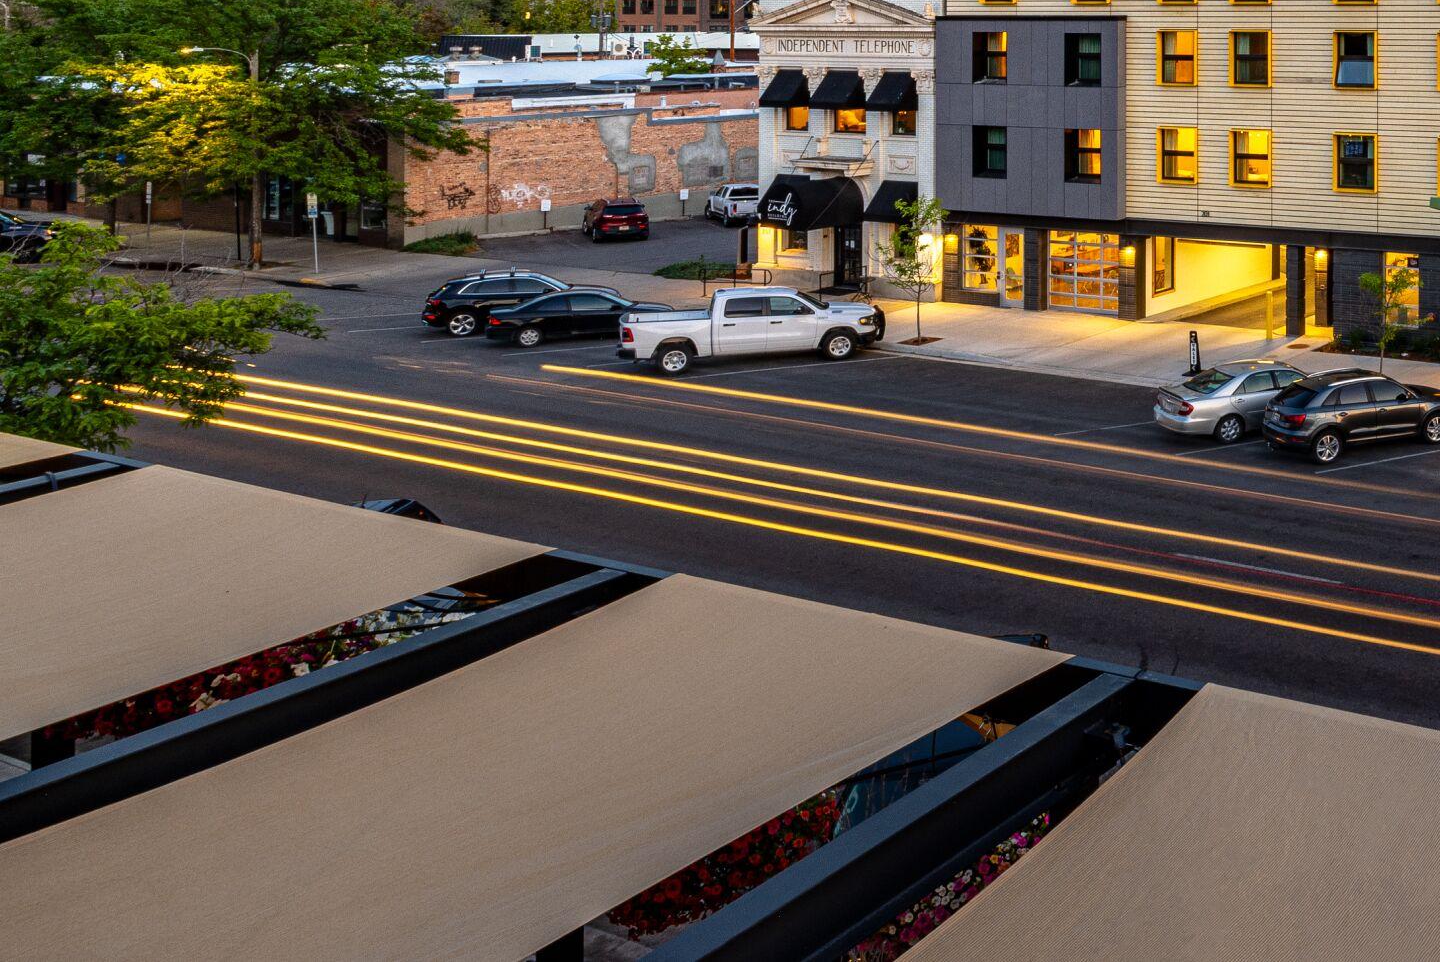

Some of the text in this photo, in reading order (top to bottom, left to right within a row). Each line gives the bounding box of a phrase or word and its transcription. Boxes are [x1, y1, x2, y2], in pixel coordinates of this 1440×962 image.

[778, 39, 915, 54] INDEPENDENT TELEPHONE
[768, 193, 797, 226] indy
